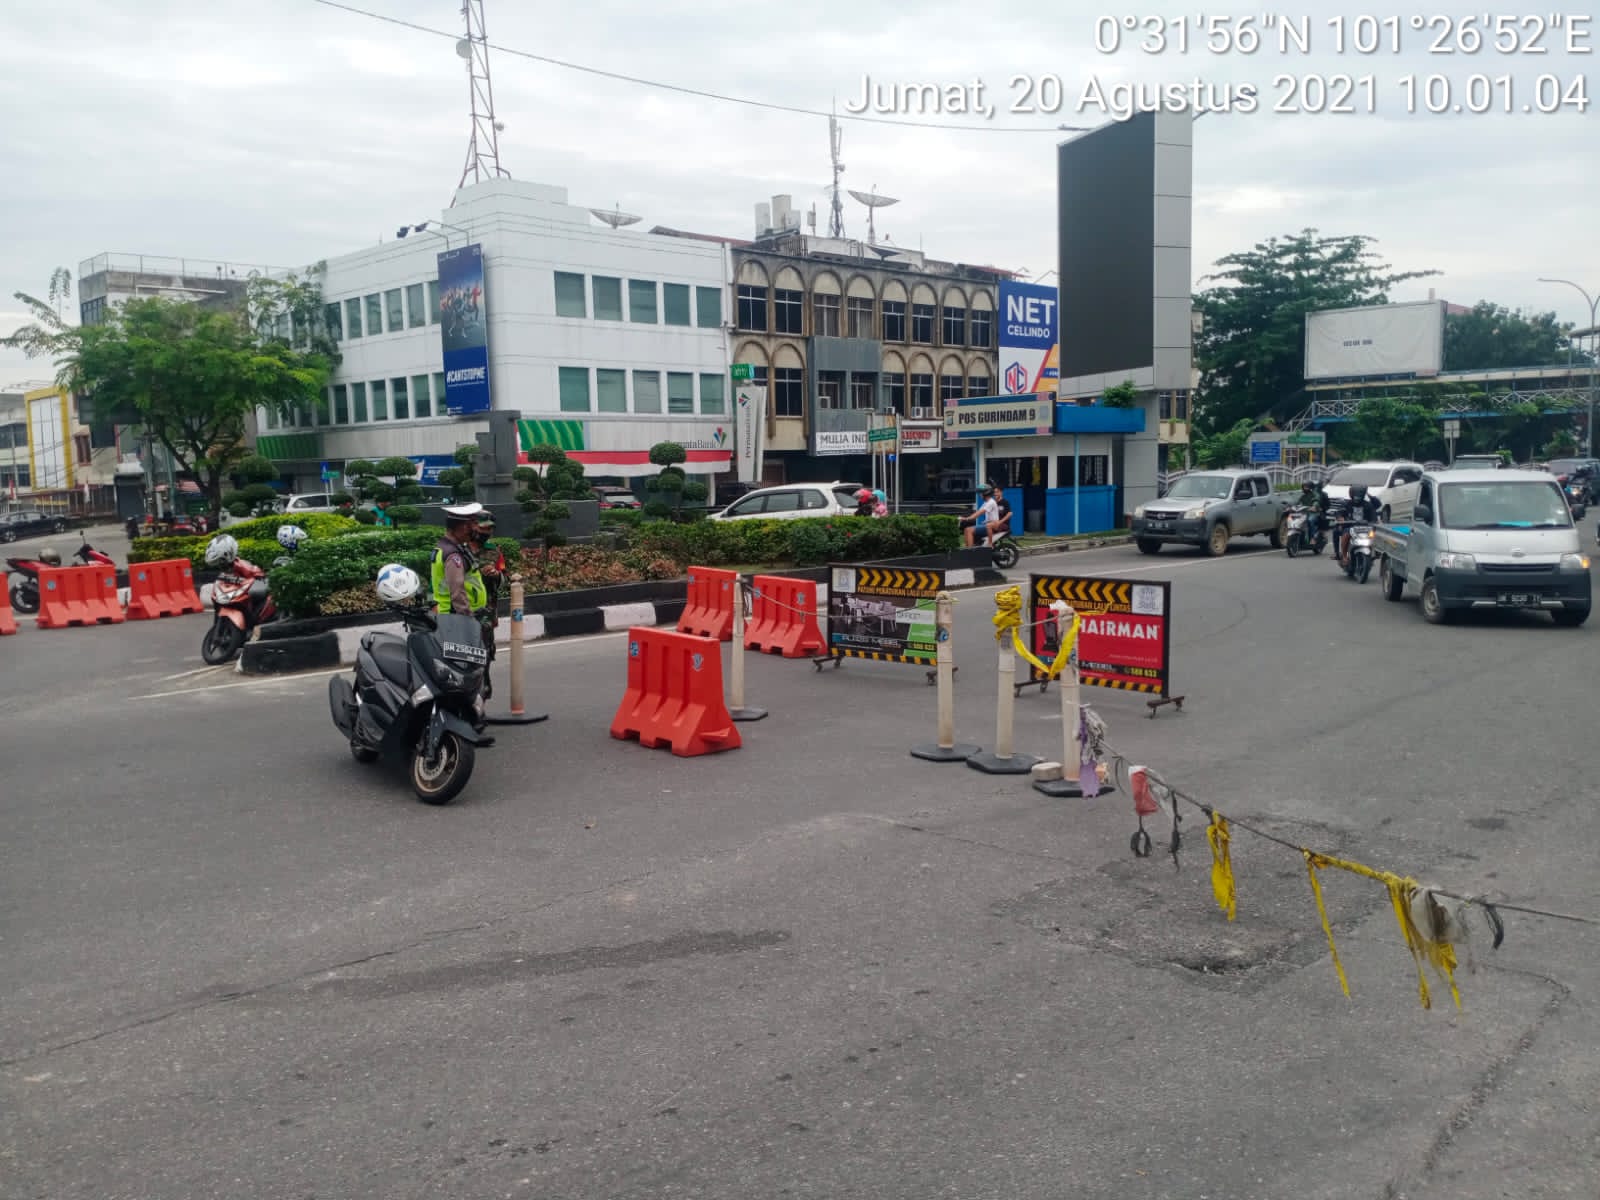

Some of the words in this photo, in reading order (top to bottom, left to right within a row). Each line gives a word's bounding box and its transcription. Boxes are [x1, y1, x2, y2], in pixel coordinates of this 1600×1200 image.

[1007, 294, 1056, 325] NET
[1007, 324, 1050, 339] CELLINDO
[958, 412, 976, 425] POS
[978, 408, 1027, 424] GURINDAM
[1029, 408, 1036, 421] 9
[819, 433, 850, 445] MULIA
[1079, 618, 1158, 640] HAIRMAN
